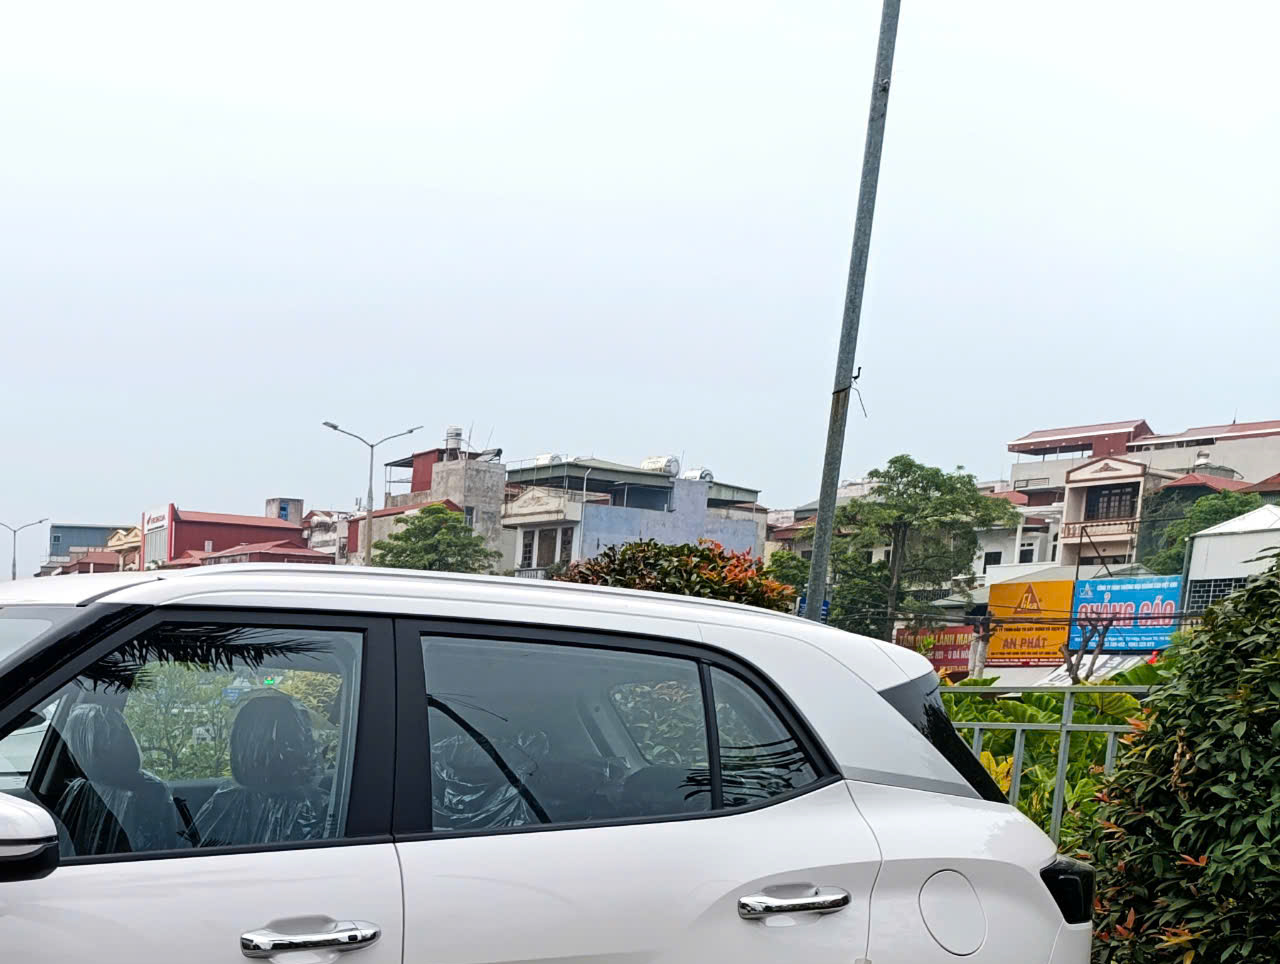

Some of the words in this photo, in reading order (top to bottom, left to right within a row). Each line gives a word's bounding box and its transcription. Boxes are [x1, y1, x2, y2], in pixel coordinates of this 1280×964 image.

[1077, 592, 1135, 629] QUẢNG
[1139, 595, 1175, 628] CÁO
[1002, 637, 1017, 649] AN
[1020, 634, 1048, 650] PHÁT
